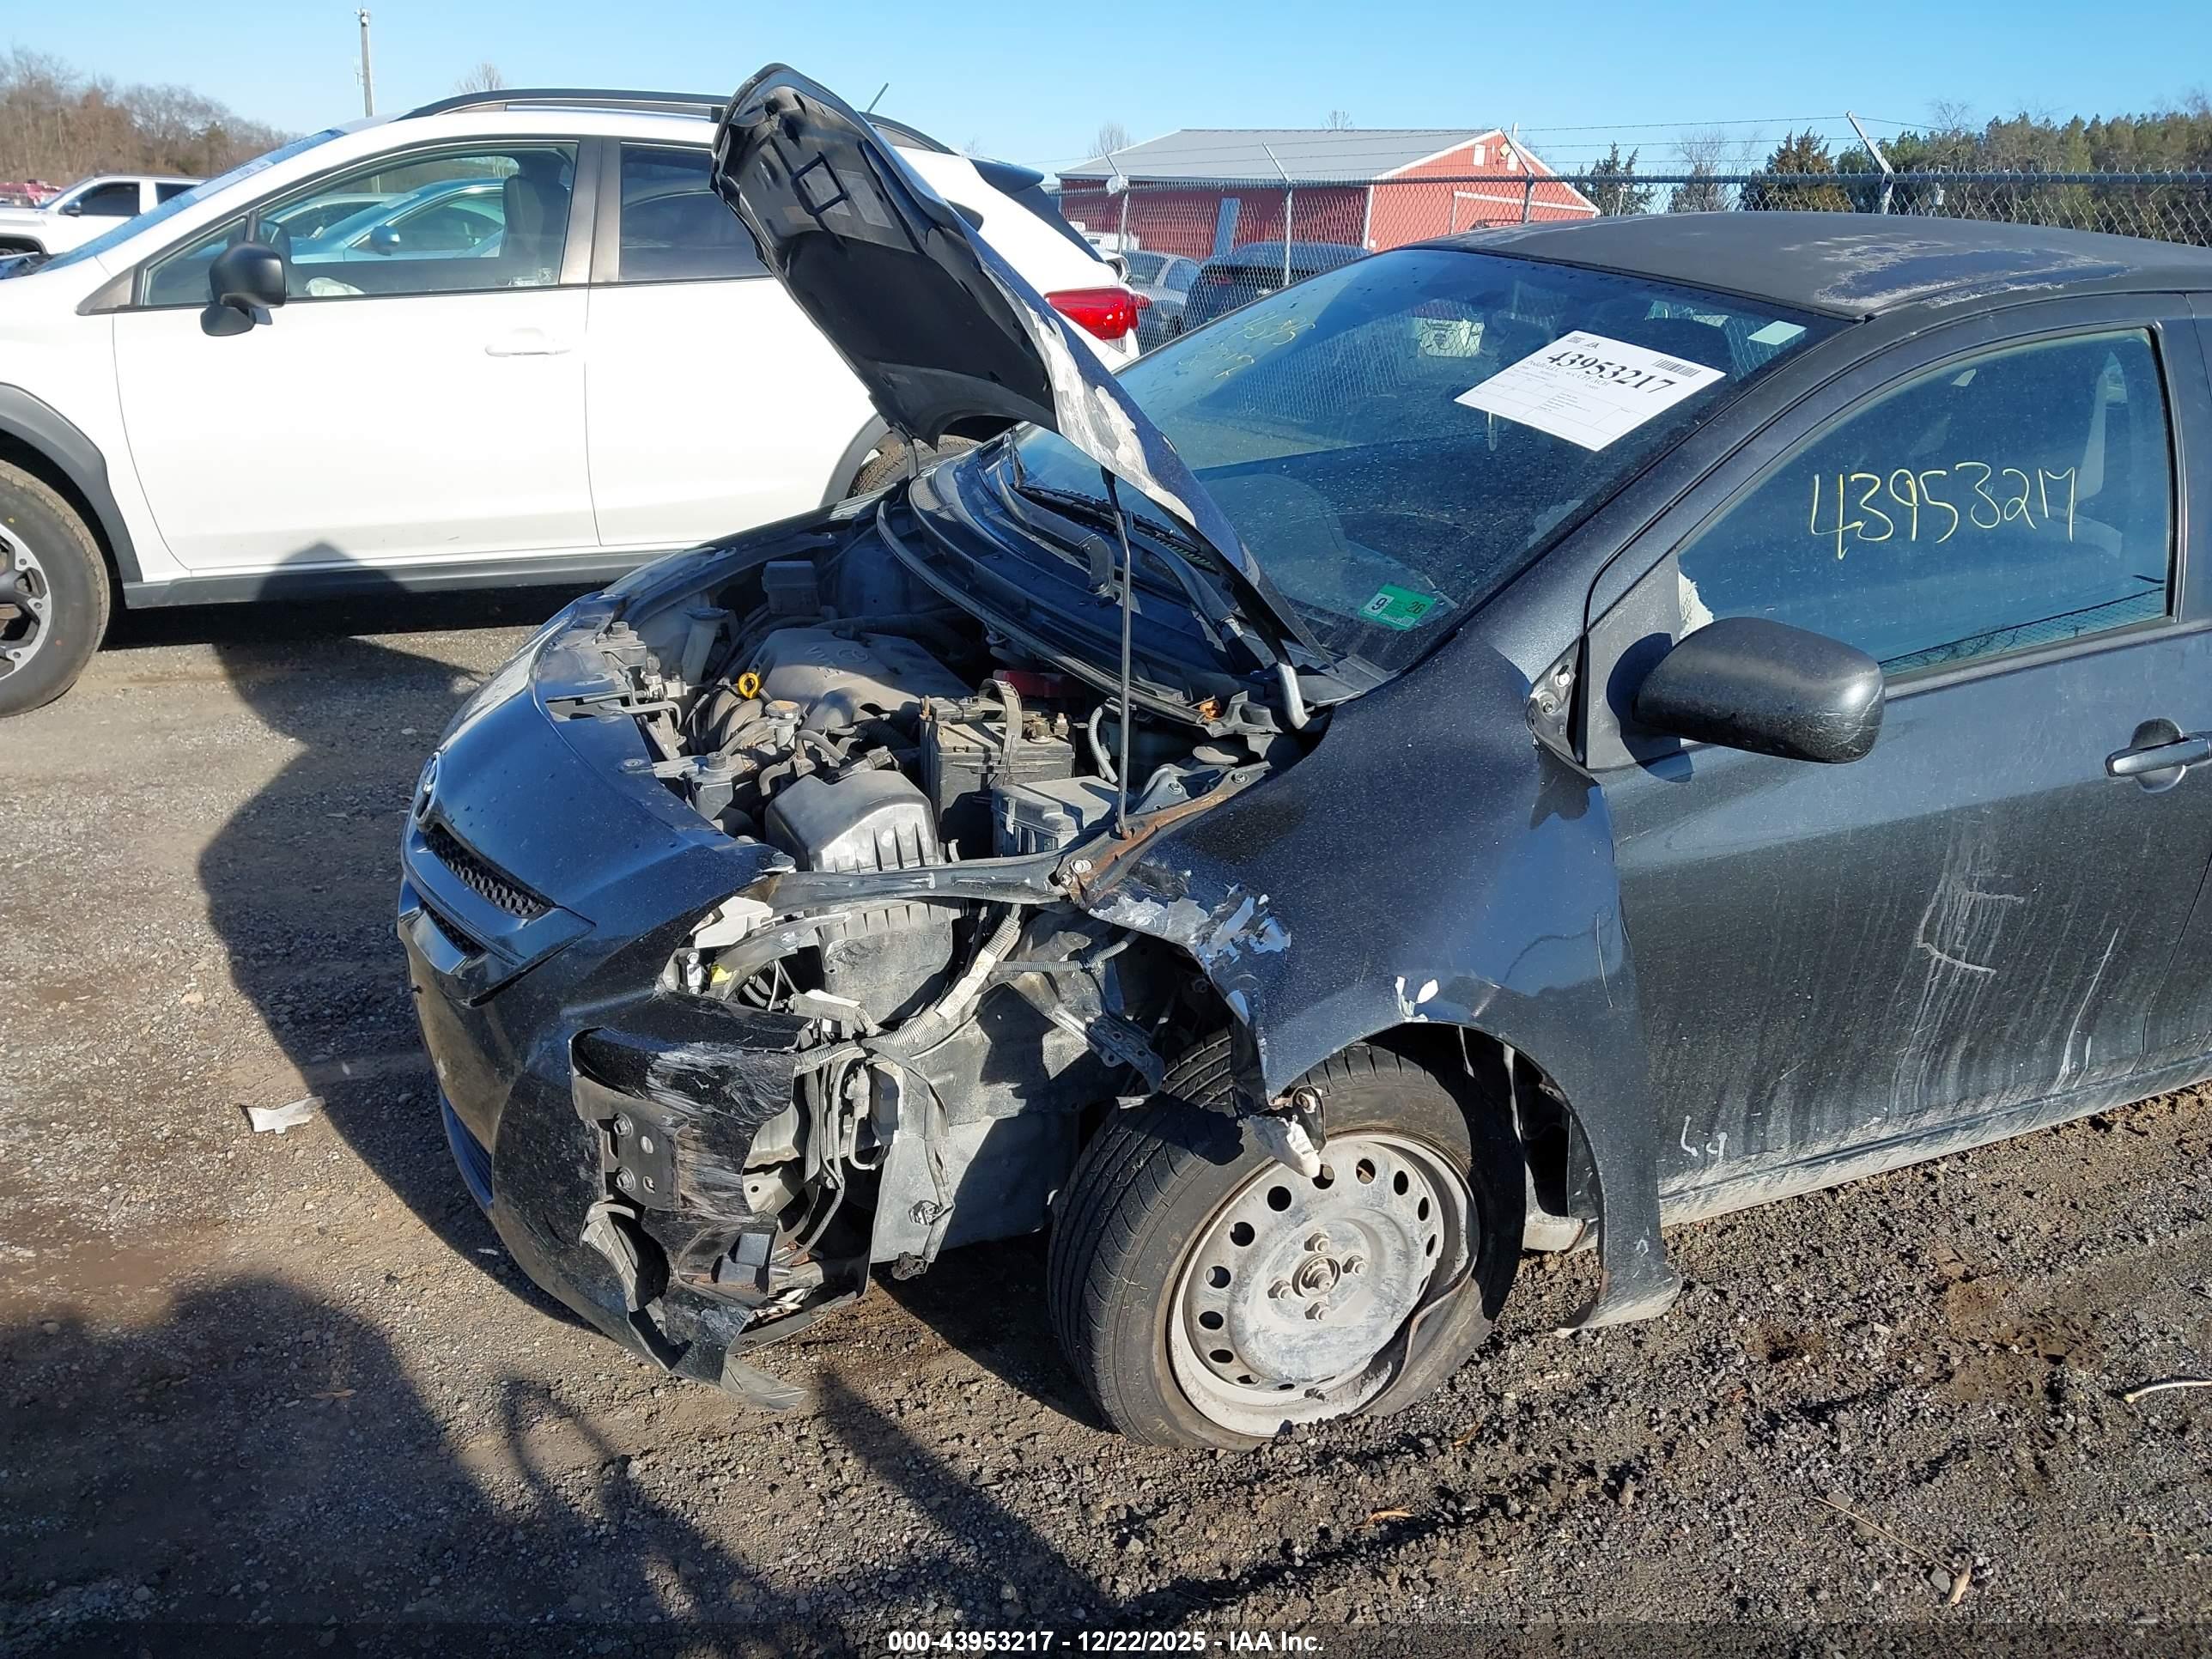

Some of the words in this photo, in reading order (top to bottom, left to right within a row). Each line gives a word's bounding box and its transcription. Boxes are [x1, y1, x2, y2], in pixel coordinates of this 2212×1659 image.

[1547, 350, 1677, 393] 43953217
[1811, 461, 2076, 560] 43953217
[1371, 598, 1388, 611] 9
[1407, 601, 1425, 614] 26
